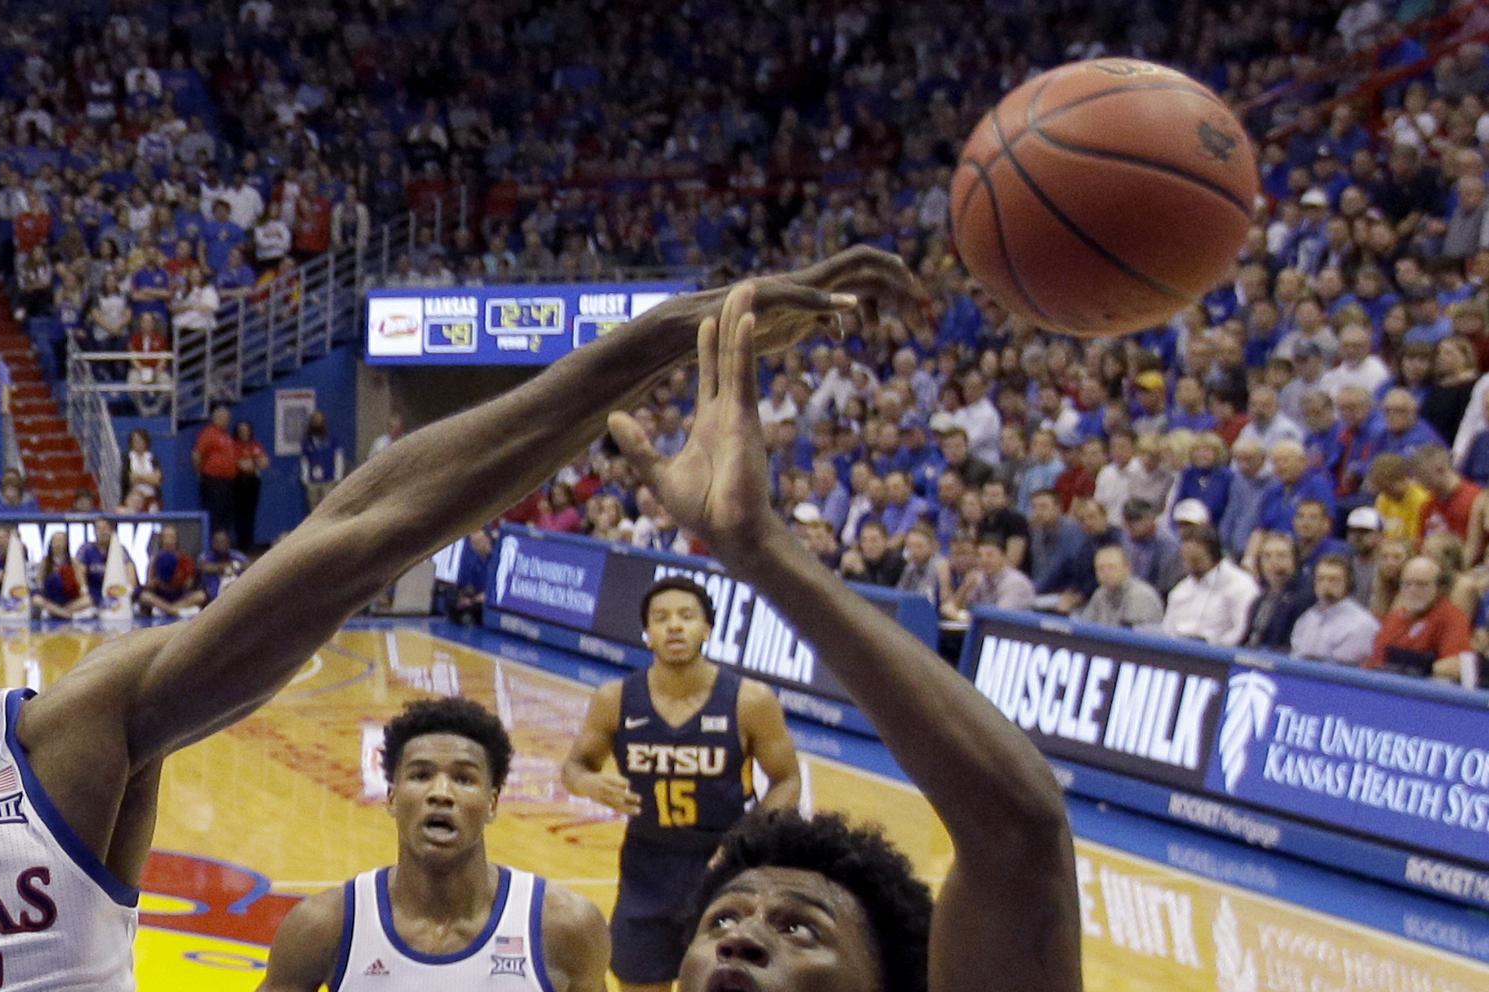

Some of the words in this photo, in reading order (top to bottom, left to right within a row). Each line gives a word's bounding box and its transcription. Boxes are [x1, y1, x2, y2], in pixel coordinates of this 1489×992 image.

[975, 635, 1114, 744] MUSCLE
[1103, 661, 1218, 770] MILK
[626, 743, 727, 776] ETSU
[1274, 704, 1323, 749] THE
[1320, 714, 1463, 781] UNIVERSITY
[1462, 748, 1489, 787] O
[654, 779, 699, 827] 15
[1263, 742, 1351, 797] KANSAS
[1348, 761, 1445, 821] HEALTH
[1443, 783, 1489, 833] SYS
